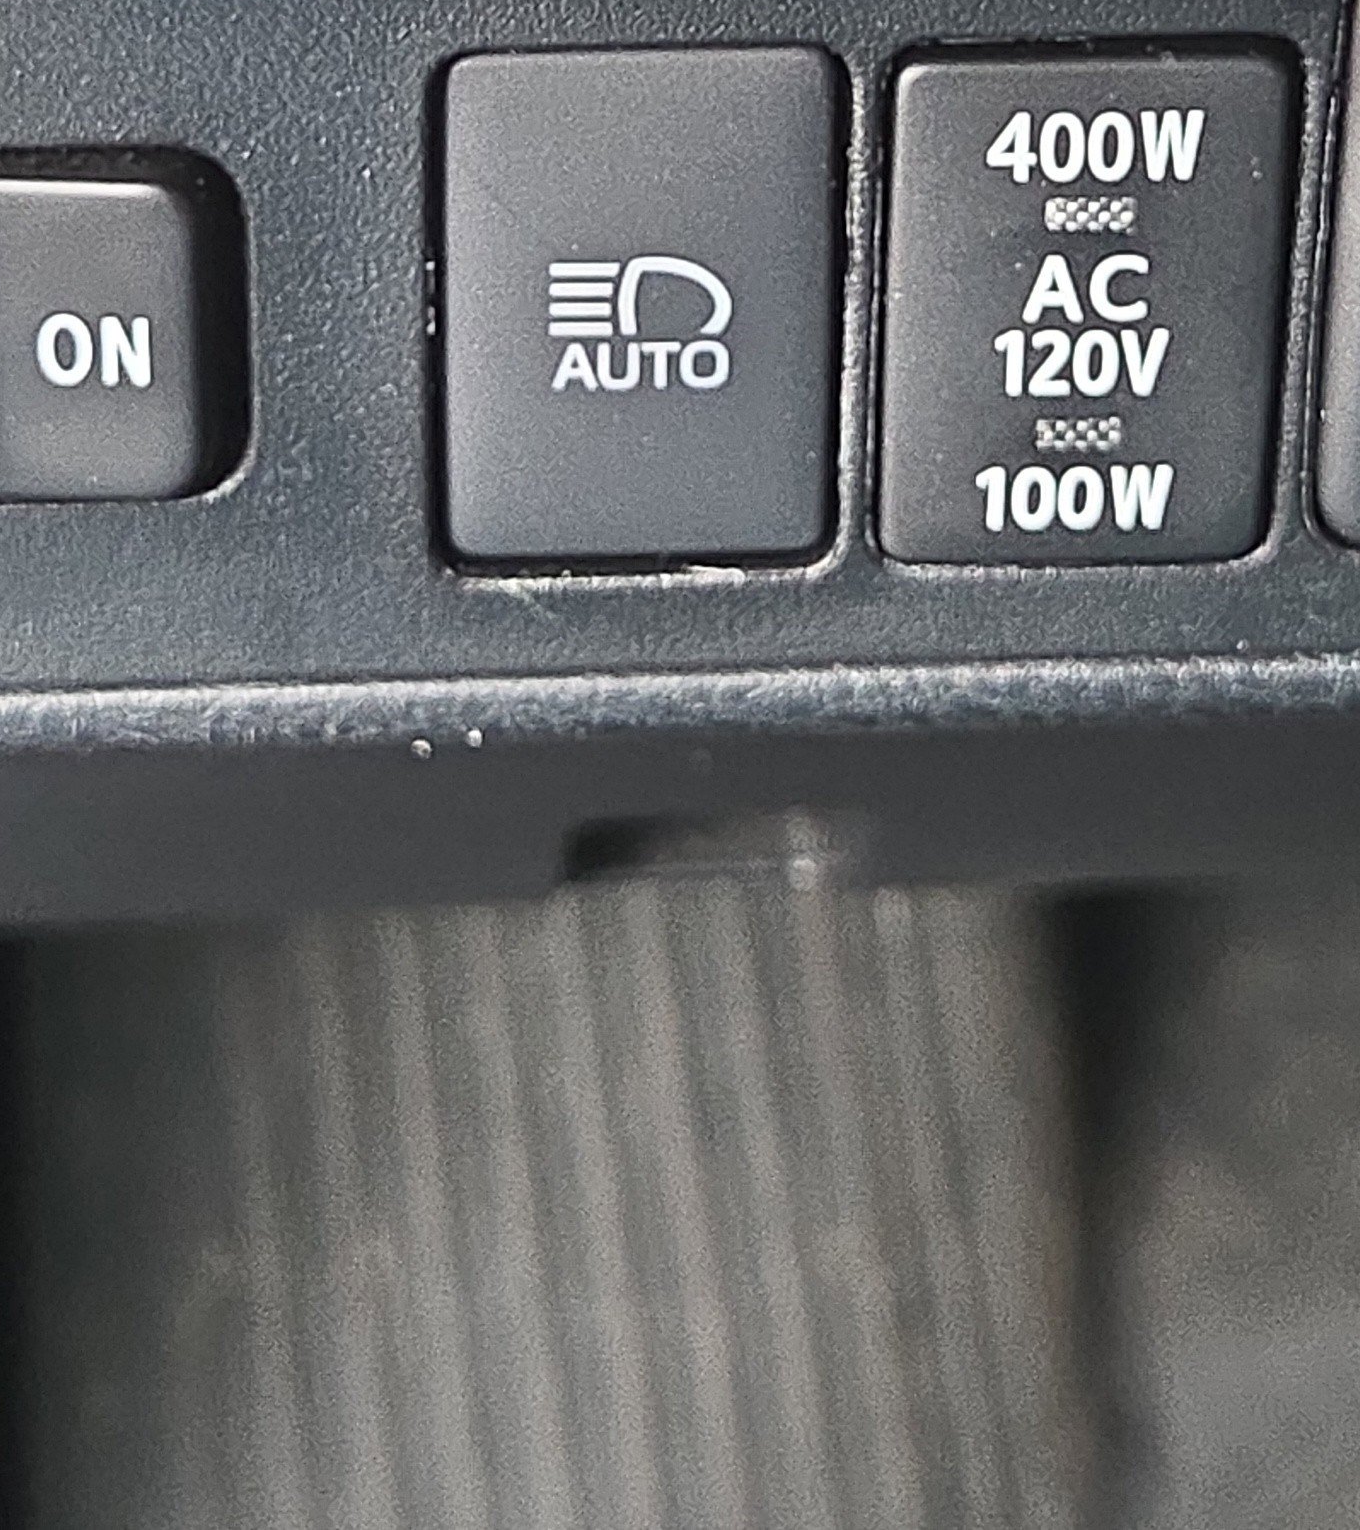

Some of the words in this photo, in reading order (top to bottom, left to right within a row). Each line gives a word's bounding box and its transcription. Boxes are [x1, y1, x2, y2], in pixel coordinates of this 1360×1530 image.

[985, 108, 1206, 184] 400W
[1021, 253, 1150, 325] AC
[36, 312, 152, 389] ON
[550, 339, 730, 393] AUTO
[993, 326, 1171, 398] 120V
[974, 463, 1175, 533] 100W
